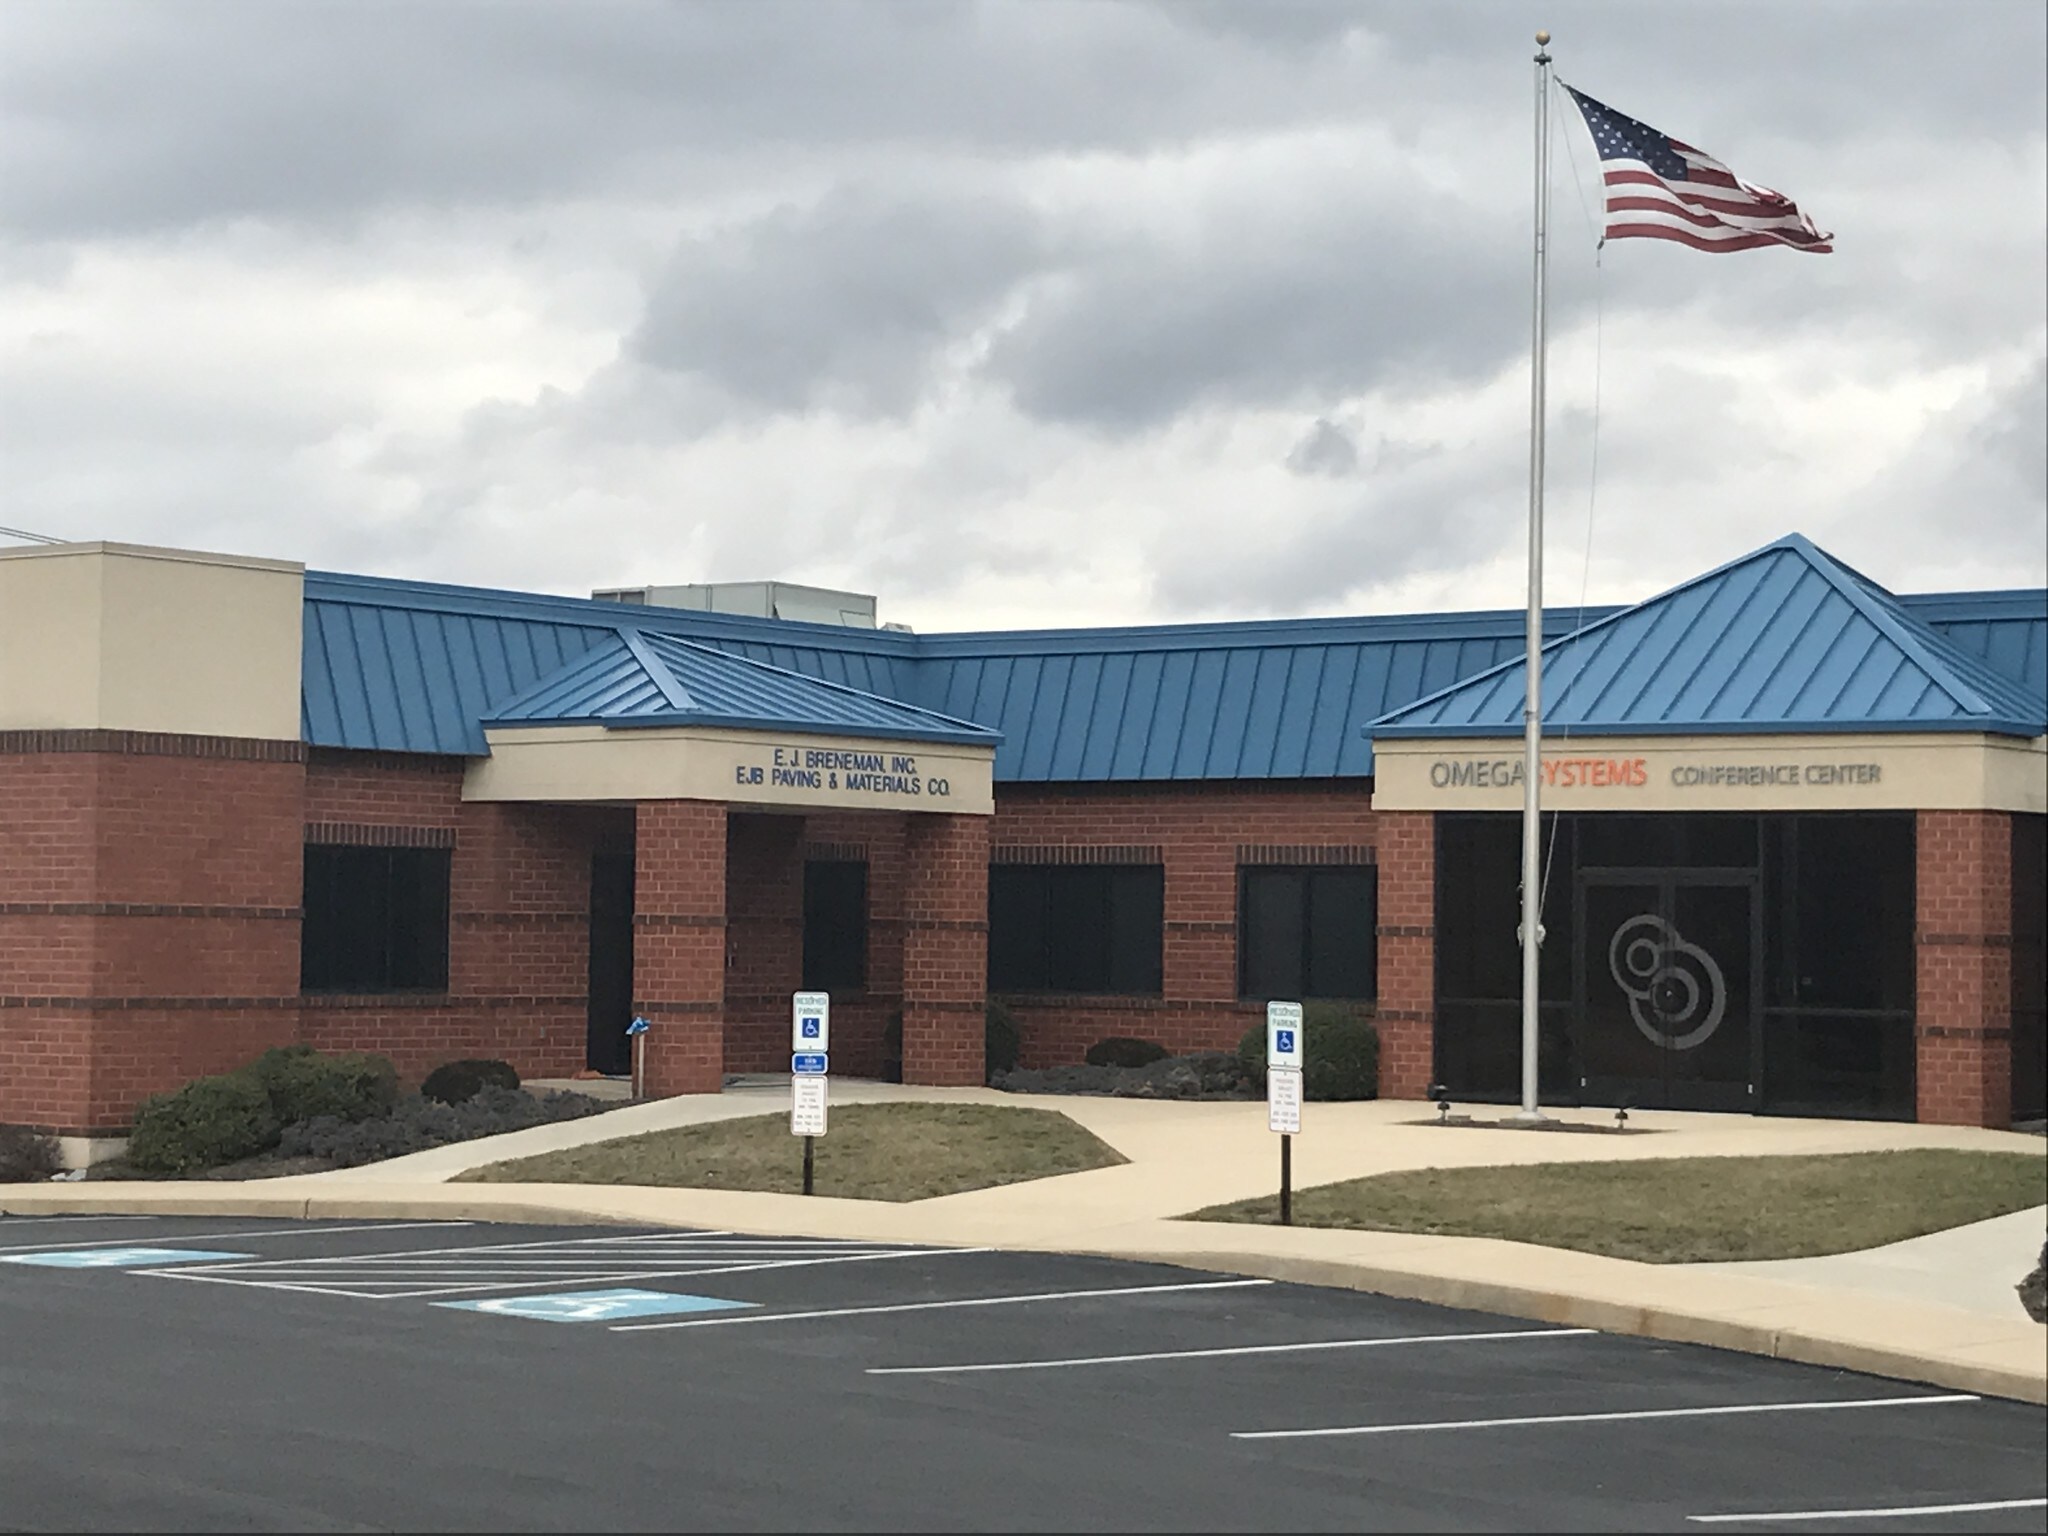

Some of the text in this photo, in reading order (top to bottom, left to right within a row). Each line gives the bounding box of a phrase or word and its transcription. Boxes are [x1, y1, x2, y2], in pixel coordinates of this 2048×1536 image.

[892, 756, 917, 774] INC.
[1671, 764, 1882, 786] CONFERENCE CENTER
[736, 766, 764, 785] EJB
[772, 768, 821, 789] PAVING
[829, 772, 838, 789] &
[846, 773, 921, 794] MATERIALS
